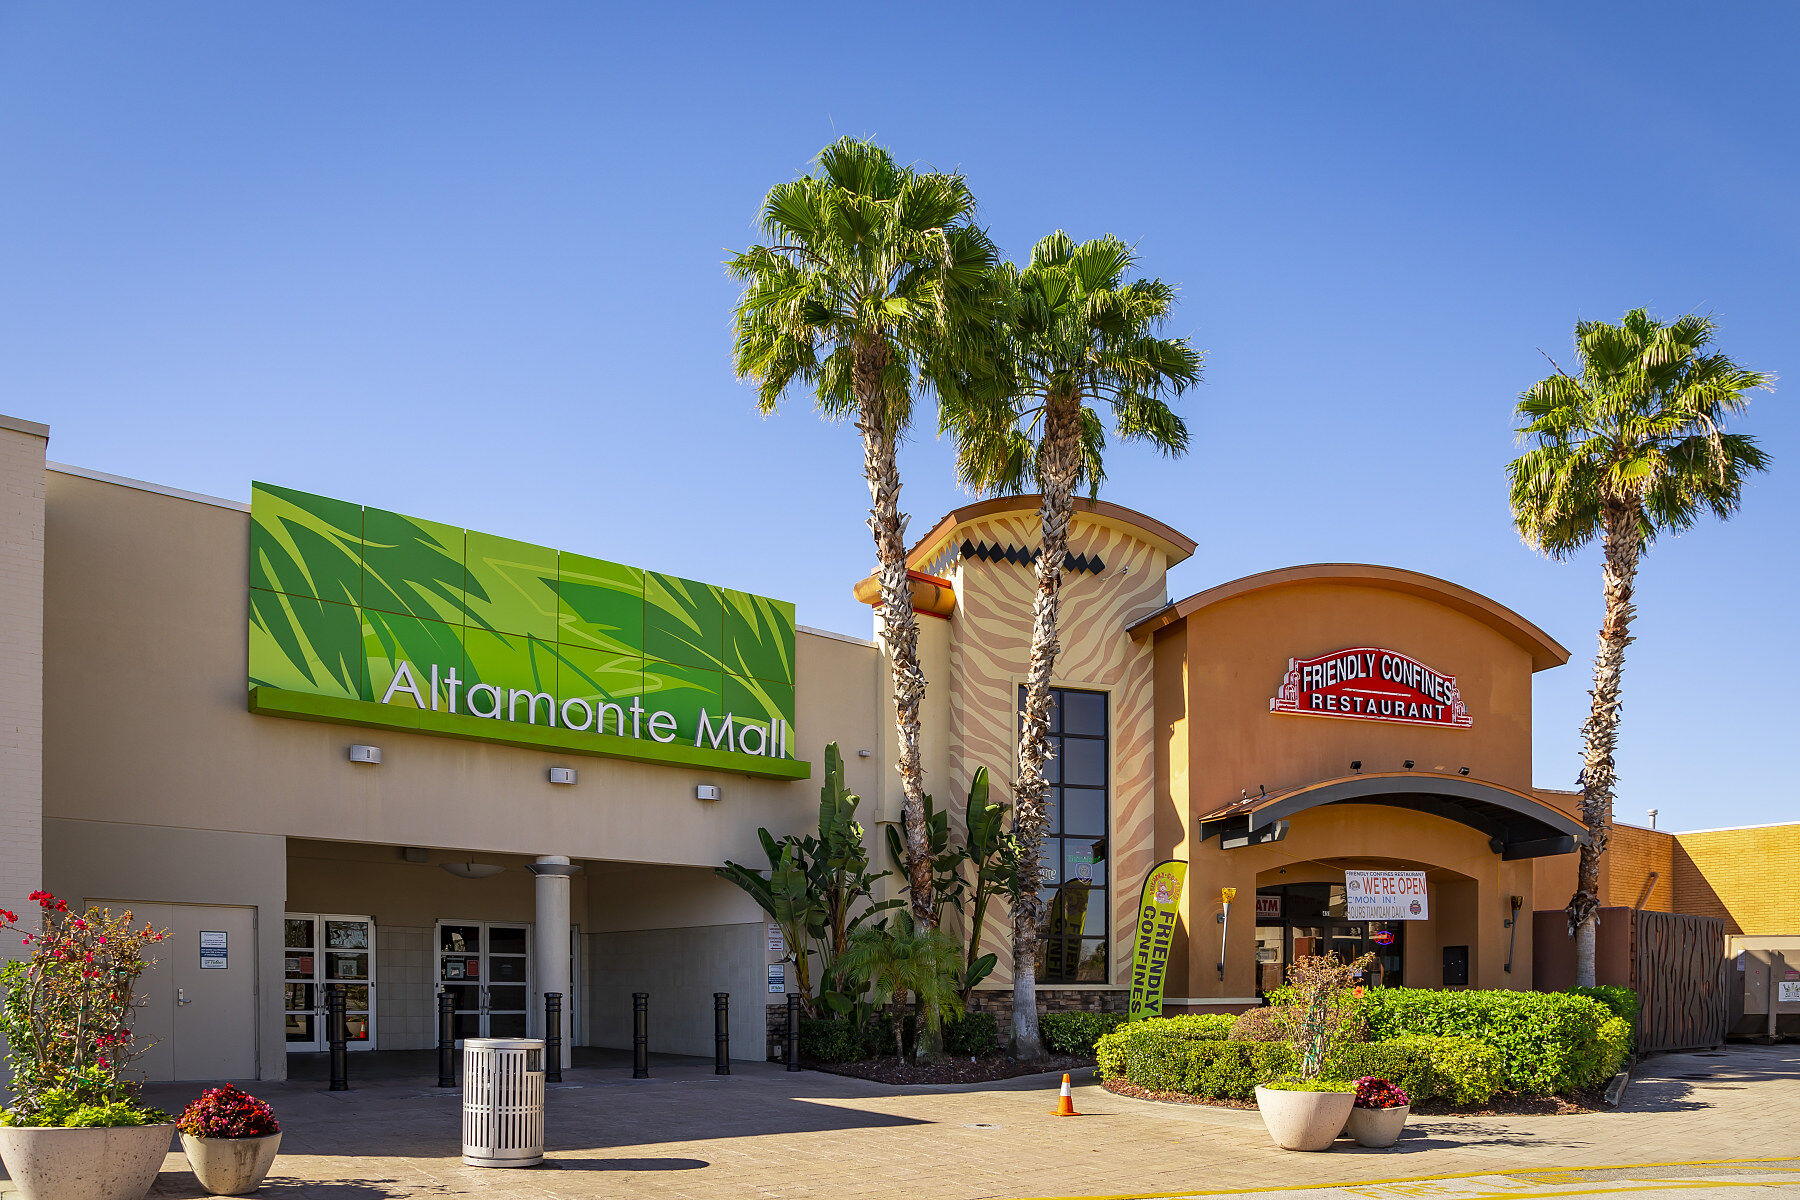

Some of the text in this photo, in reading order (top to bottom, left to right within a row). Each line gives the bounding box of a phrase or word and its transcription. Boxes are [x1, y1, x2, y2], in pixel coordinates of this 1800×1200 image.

[1302, 653, 1452, 706] FRIENDLY CONFINES
[381, 660, 786, 759] Altamonte Mall
[1311, 693, 1446, 720] RESTAURANT
[1256, 899, 1278, 912] ATM
[1347, 896, 1377, 904] C'MON
[1362, 877, 1427, 895] WE'RE OPEN
[1131, 905, 1156, 1014] CONFINES
[1144, 910, 1175, 1013] FRIENDLY
